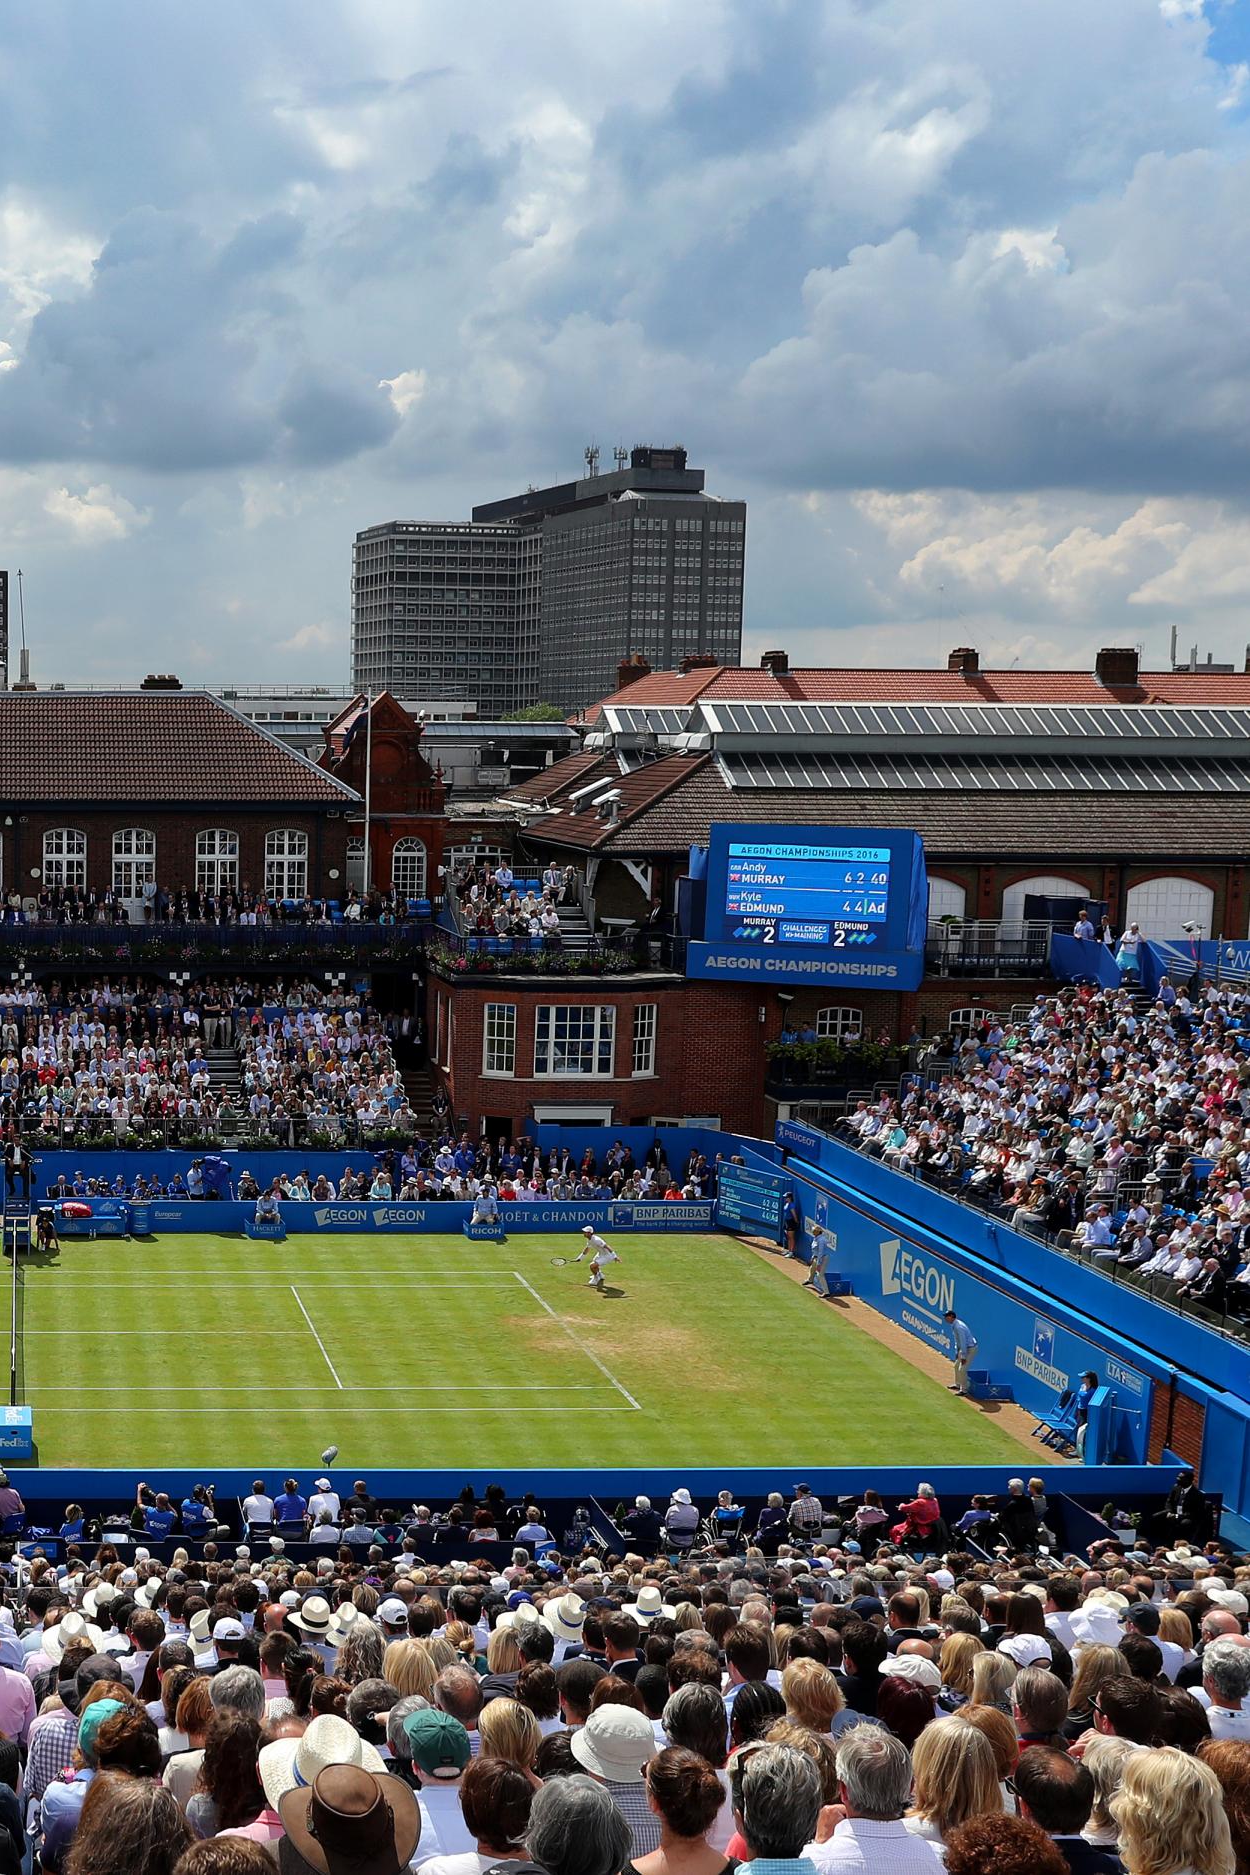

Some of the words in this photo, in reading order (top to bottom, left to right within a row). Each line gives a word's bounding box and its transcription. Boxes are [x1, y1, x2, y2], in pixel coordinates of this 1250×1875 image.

[741, 847, 772, 855] AEGON
[775, 848, 853, 858] CHAMPIONSHIPS
[857, 851, 878, 859] 2016
[742, 862, 766, 874] Andy
[741, 874, 785, 885] MURRAY
[844, 872, 852, 884] 6
[856, 873, 865, 884] 2
[870, 874, 887, 885] 40
[741, 891, 762, 902] Kyle
[740, 902, 785, 914] EDMUND
[842, 901, 851, 912] 4
[854, 902, 863, 912] 4
[867, 902, 885, 914] Ad
[743, 917, 776, 926] MURRAY
[834, 921, 869, 931] EDMUND
[763, 926, 775, 943] 2
[782, 924, 827, 933] CHALLENGES
[833, 929, 846, 947] 2
[705, 956, 761, 970] AEGON
[764, 958, 898, 977] CHAMPIONSHIPS
[784, 1129, 815, 1147] PEUGEOT
[154, 1210, 182, 1218] Europcar
[318, 1209, 367, 1222] AEGON
[377, 1209, 425, 1222] AEGON
[532, 1213, 539, 1221] &
[542, 1211, 604, 1221] CHANDON
[636, 1208, 659, 1218] BNP
[662, 1208, 709, 1218] PARIBAS
[886, 1242, 955, 1312] AEGON
[902, 1310, 950, 1349] CHAMPIONSHIPS
[1016, 1350, 1032, 1369] BNP
[1034, 1358, 1067, 1390] PARIBAS
[1107, 1362, 1121, 1382] LTA
[0, 1437, 30, 1448] FedEx
